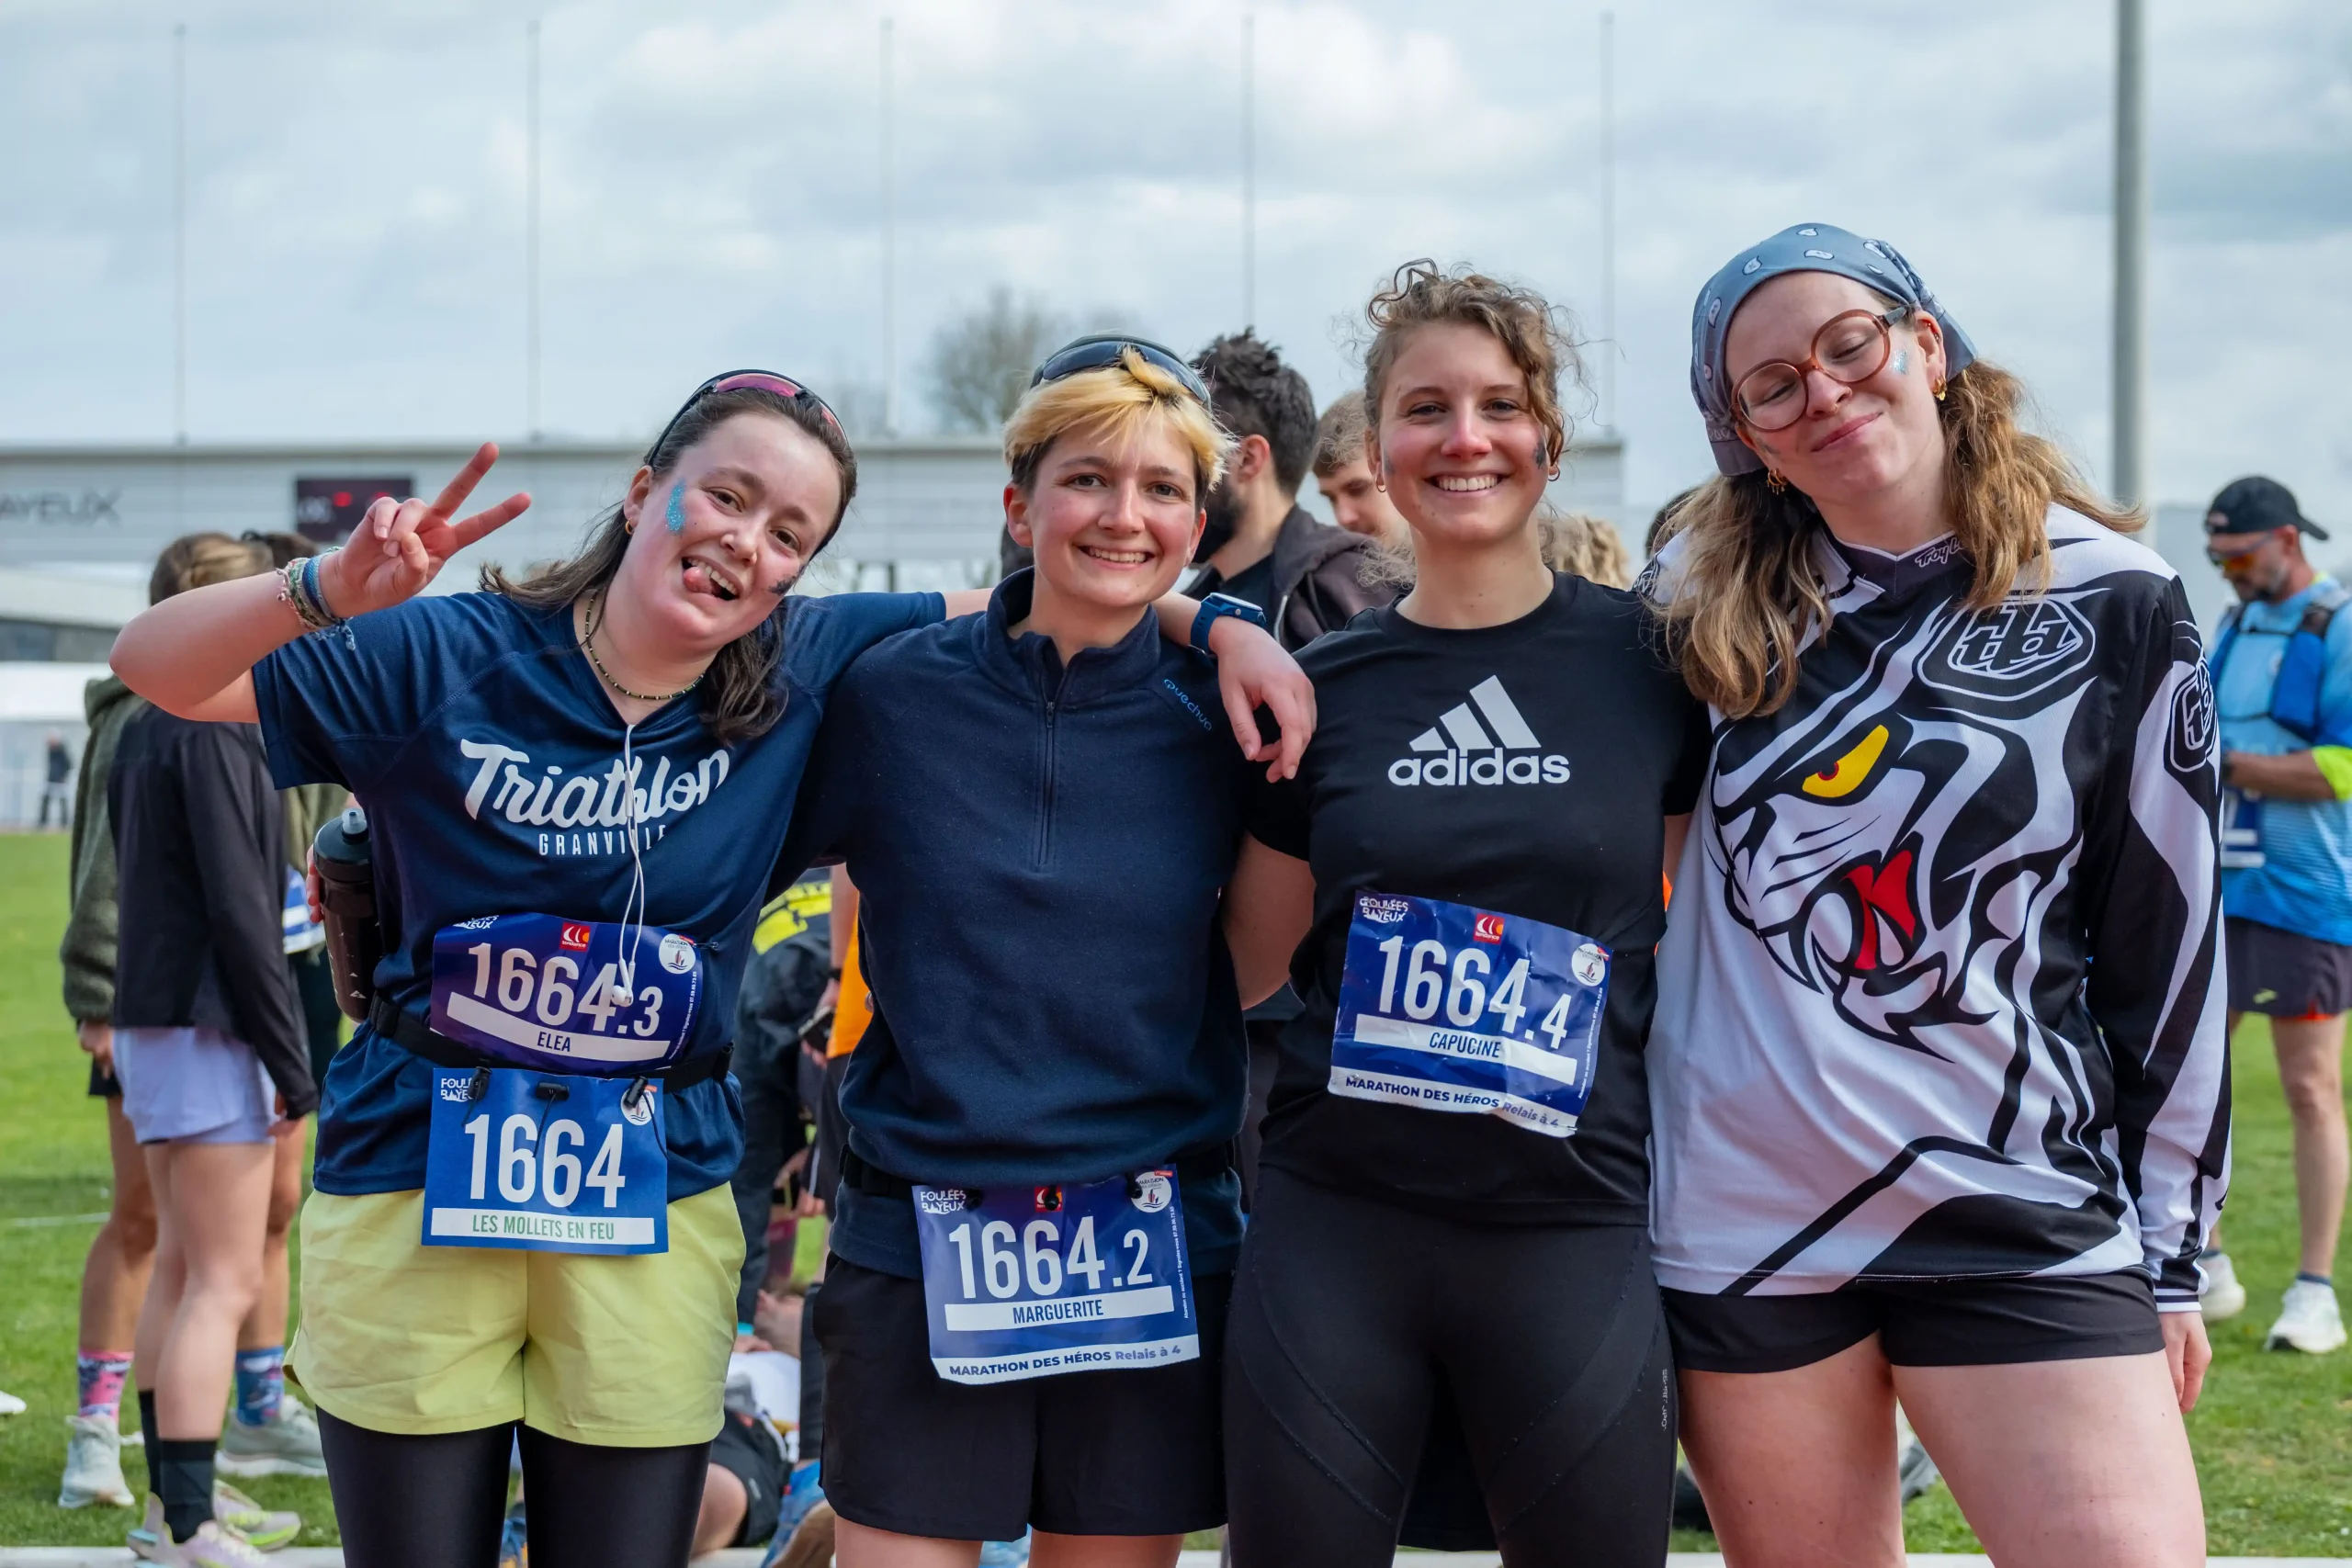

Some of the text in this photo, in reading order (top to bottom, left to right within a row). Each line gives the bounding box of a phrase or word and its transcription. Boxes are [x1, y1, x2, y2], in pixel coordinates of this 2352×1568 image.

[1915, 546, 1949, 568] Troy
[1164, 679, 1213, 731] Quechua
[1388, 748, 1570, 786] adidas
[460, 738, 730, 829] Triathlon
[469, 942, 663, 1037] 1664.3
[1378, 935, 1572, 1050] 1664.4
[537, 1031, 571, 1053] ELEA
[1429, 1032, 1502, 1058] CAPUCINE
[441, 1077, 472, 1089] FOUL
[441, 1089, 472, 1102] BAYE
[1345, 1076, 1420, 1098] MARATHON
[1423, 1089, 1450, 1101] DES
[1453, 1092, 1499, 1108] HÉROS
[1501, 1101, 1538, 1121] Relais
[1540, 1112, 1548, 1124] à
[464, 1113, 626, 1208] 1664
[921, 1189, 967, 1201] FOULÉES
[922, 1201, 965, 1214] BAYEUX
[473, 1214, 615, 1240] LES MOLLETS EN FEU
[949, 1215, 1153, 1299] 1664.2
[1012, 1299, 1103, 1324] MARGUERITE
[949, 1345, 1181, 1376] MARATHON DES HÉROS Relais à 4
